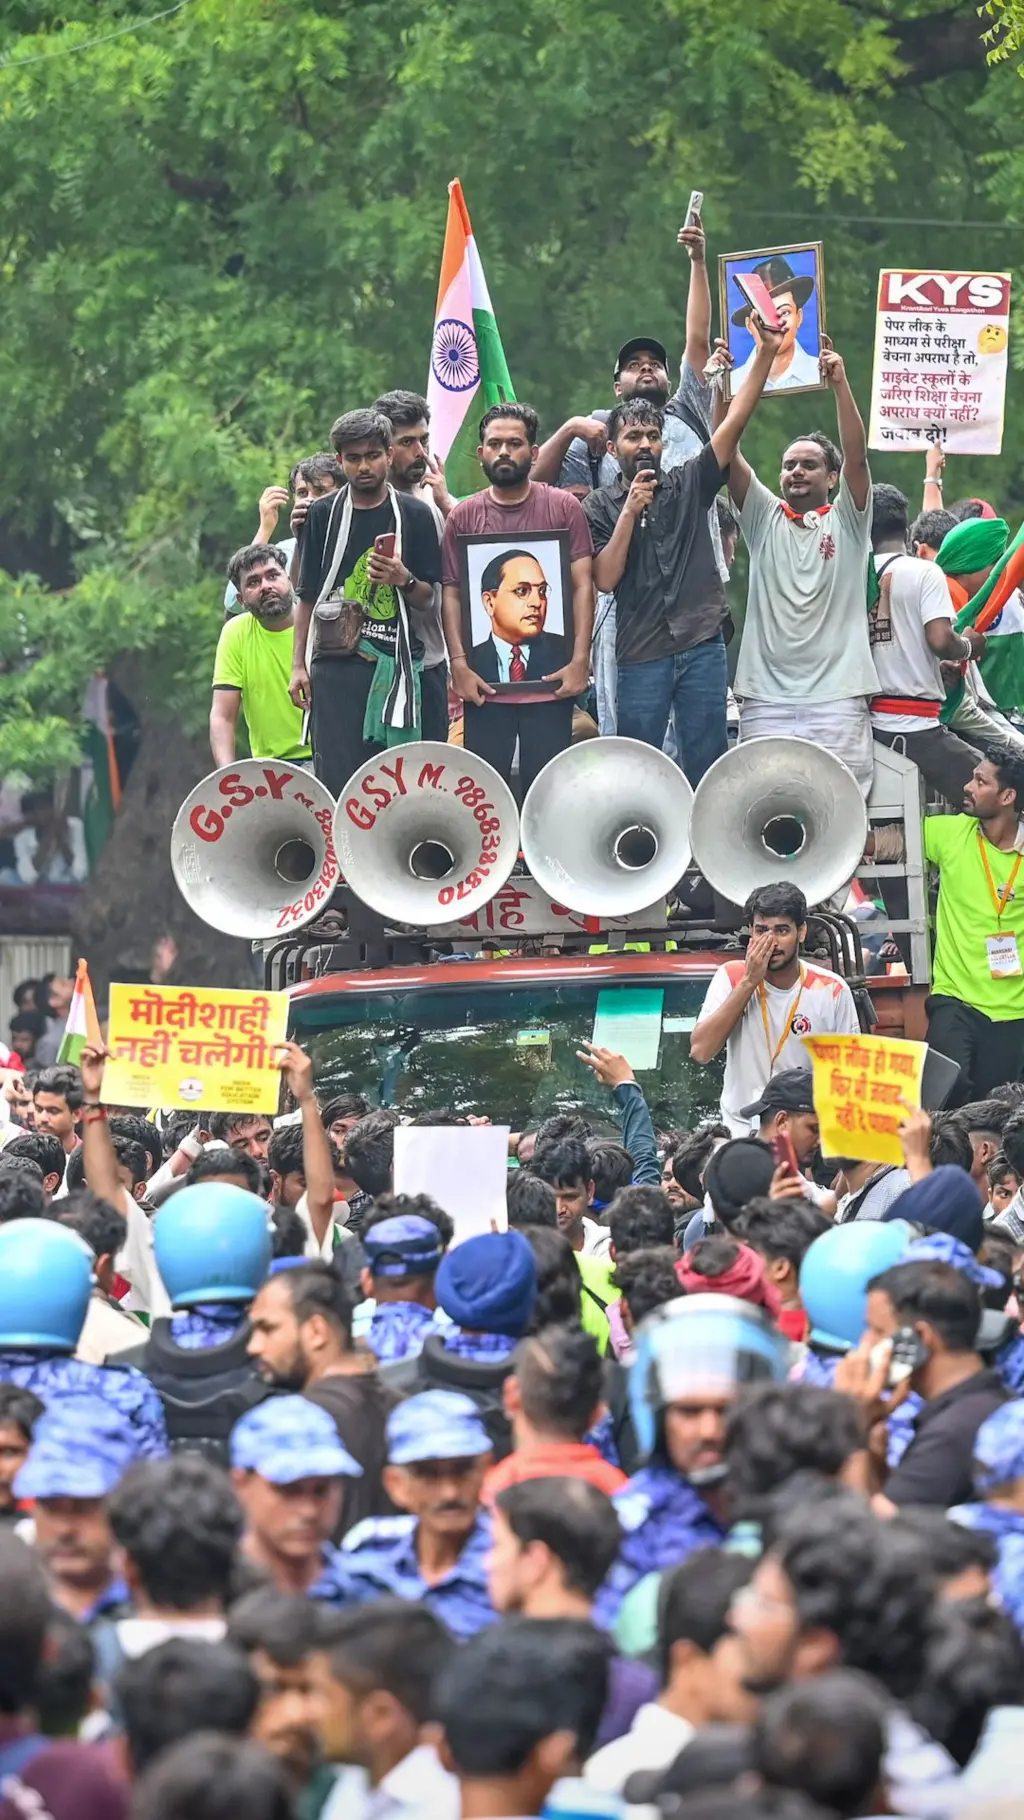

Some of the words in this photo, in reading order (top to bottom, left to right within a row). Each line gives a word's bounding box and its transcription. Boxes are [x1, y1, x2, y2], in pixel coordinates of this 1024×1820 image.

[888, 273, 1003, 308] KYS
[884, 317, 905, 331] पेपर
[908, 318, 933, 332] लीक
[935, 319, 947, 332] के
[884, 336, 918, 347] माध्यम
[921, 334, 931, 347] से
[934, 334, 966, 350] परीक्षा
[882, 348, 911, 362] बेचना
[914, 352, 950, 363] अपराध
[952, 348, 961, 365] है
[963, 351, 978, 366] तो,
[881, 368, 919, 385] प्राइवेट
[920, 370, 956, 389] स्कूलों
[958, 370, 971, 385] के
[880, 385, 912, 403] जरिए
[914, 386, 948, 404] शिक्षा
[950, 387, 982, 403] बेचना
[879, 406, 920, 419] अपराध
[923, 404, 947, 419] क्यों
[949, 404, 979, 421] नहीं?
[924, 423, 947, 444] दो!
[189, 769, 294, 842] G.S.Y
[438, 776, 501, 905] 9868381870
[129, 989, 272, 1034] मोदीशाही
[115, 1029, 178, 1068] नहीं
[178, 1033, 280, 1070] चलेगी!
